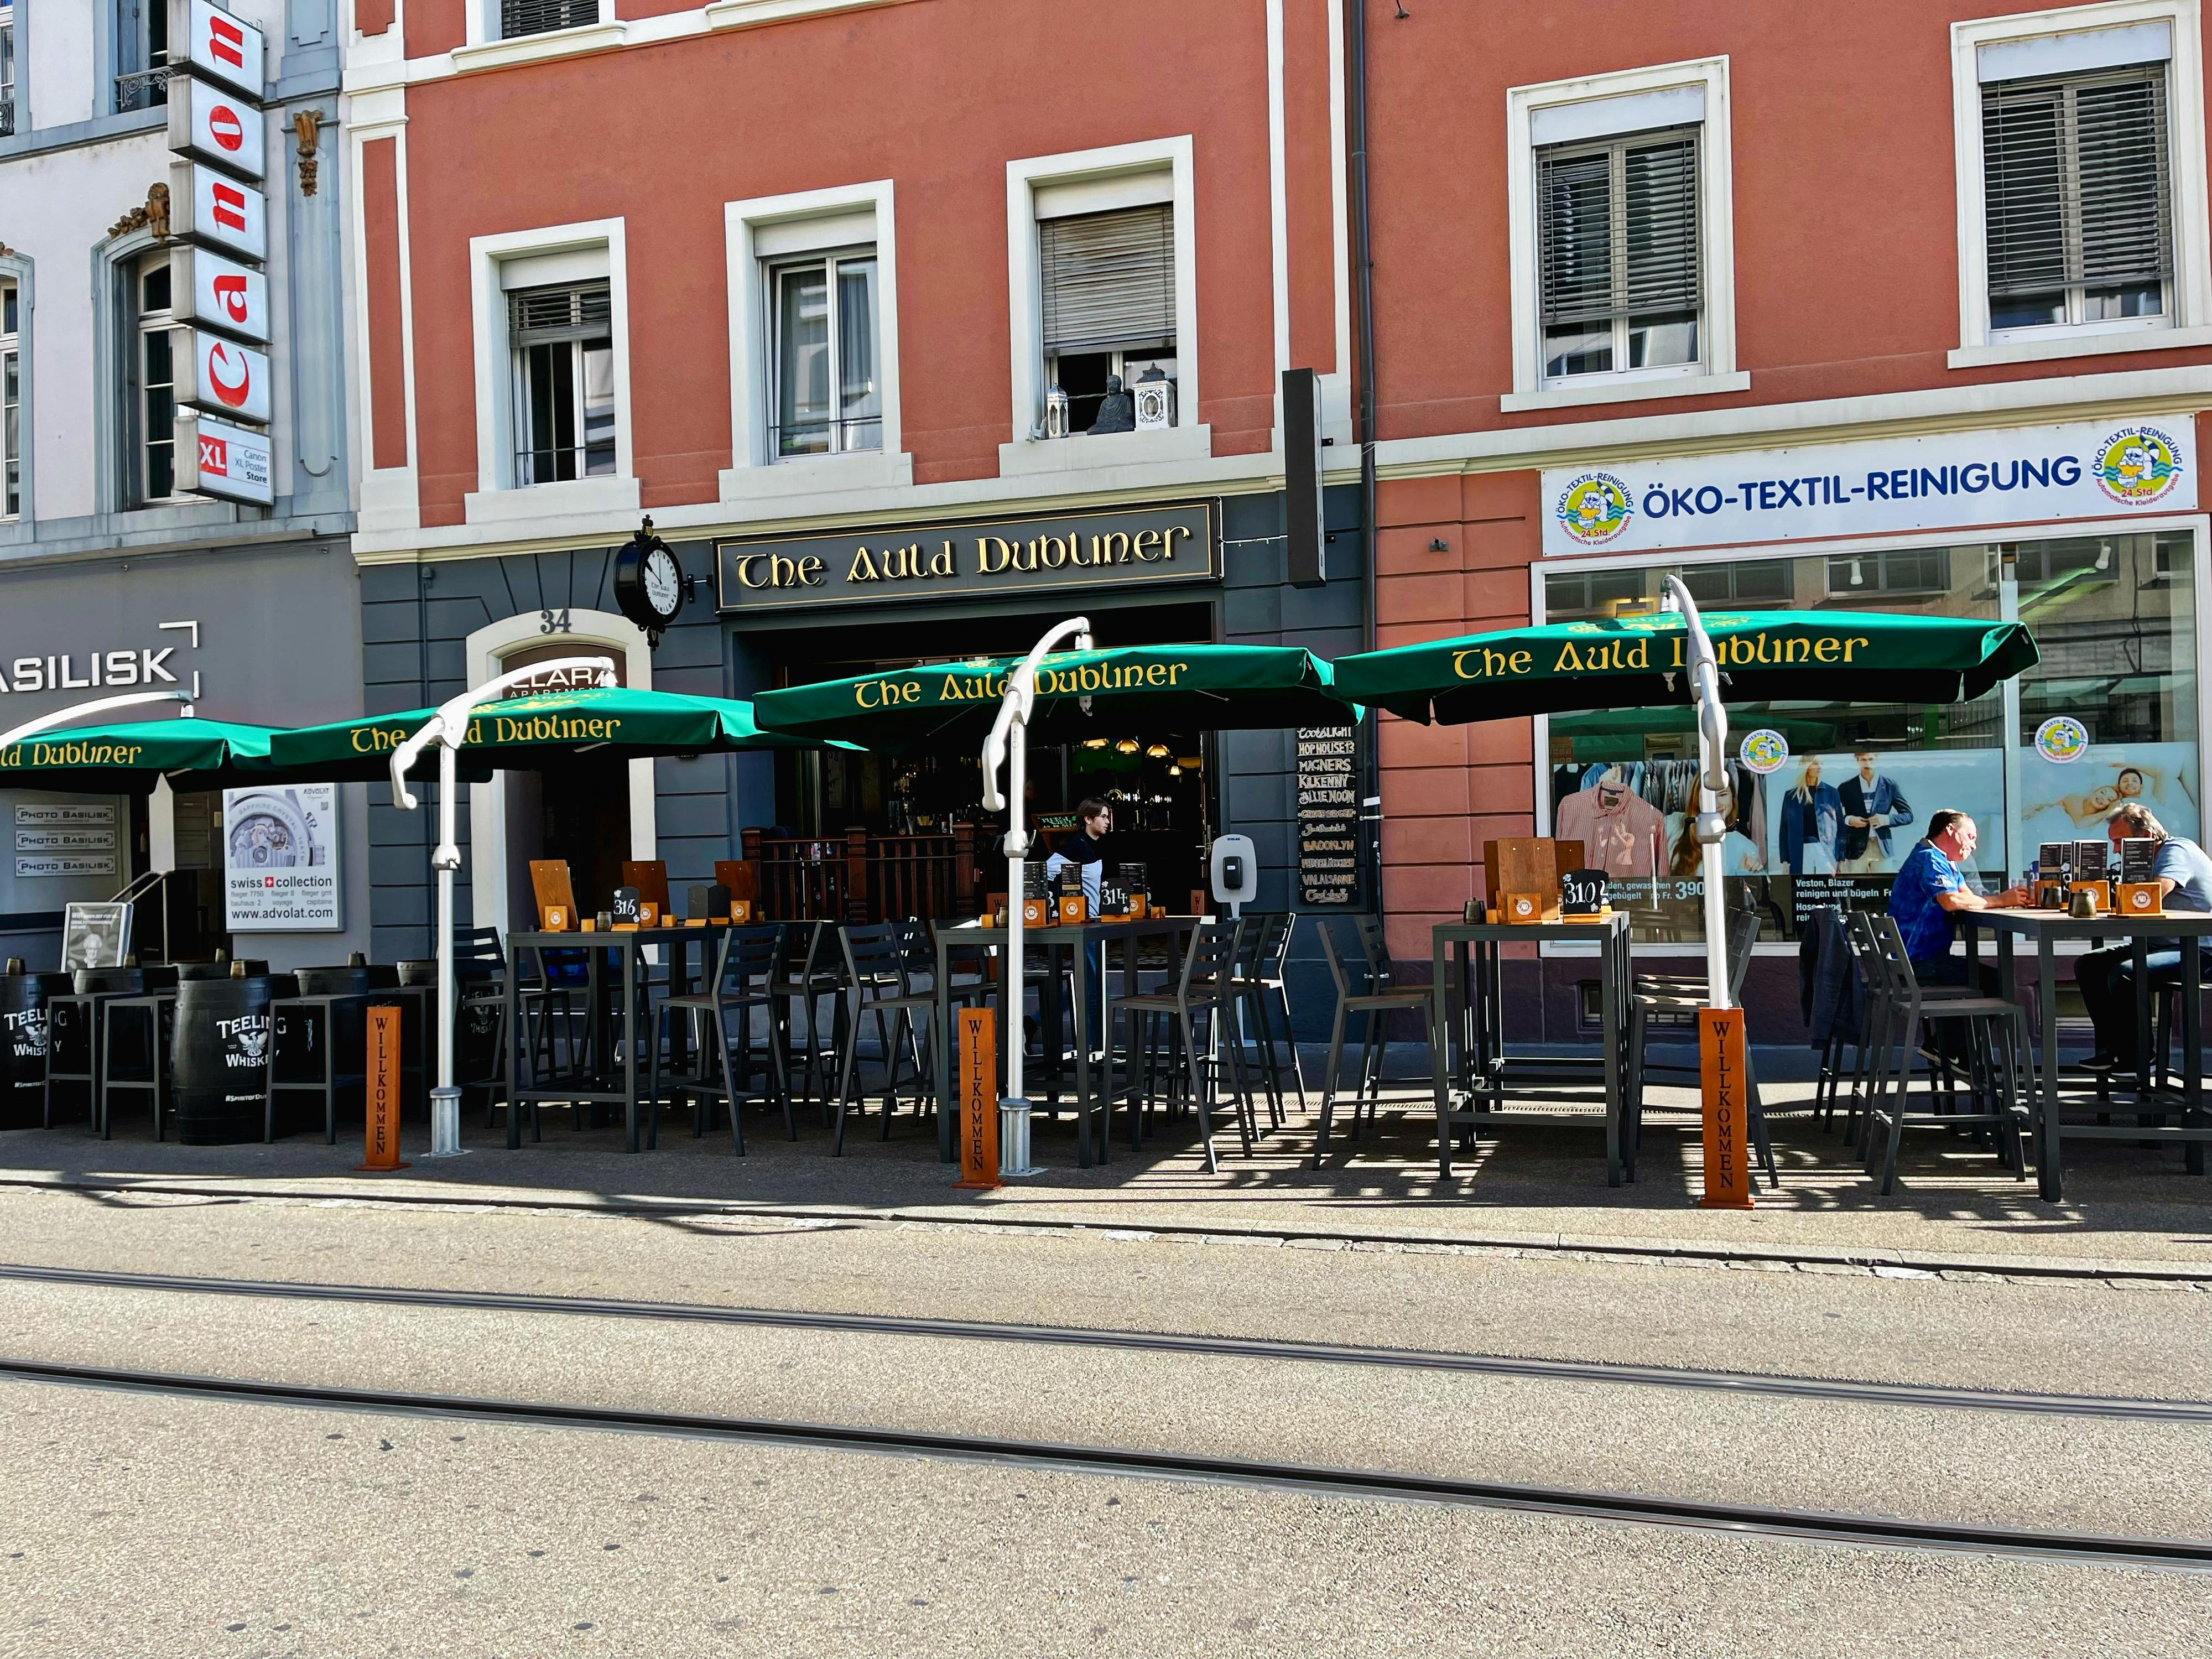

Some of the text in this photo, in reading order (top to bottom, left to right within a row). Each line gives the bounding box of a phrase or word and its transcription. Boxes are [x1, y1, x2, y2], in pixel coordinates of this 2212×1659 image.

[209, 16, 249, 408] Canon
[200, 442, 226, 469] XL
[244, 450, 267, 462] Canon
[2091, 427, 2182, 471] ÖKO-TEXTIL-REINIGUNG
[235, 458, 267, 472] XL Poster
[246, 471, 267, 483] Store
[1642, 455, 2082, 519] ÖKO-TEXTIL-REINIGUNG
[1555, 472, 1633, 513] ÖKO-TEXTIL-REINIGUNG
[2096, 473, 2179, 506] Automatische Kleiderausgabe
[2121, 487, 2156, 497] 24 Std.
[1559, 515, 1631, 545] Automatische Kleiderausgabe
[1594, 528, 1610, 537] Std.
[737, 525, 1190, 589] The Auld Dubliner
[540, 609, 571, 633] 34
[1452, 648, 1533, 679] The
[1554, 638, 1650, 672] Auld
[510, 667, 601, 688] LAR
[854, 680, 921, 708] The
[1034, 661, 1188, 695] Dubliner
[350, 728, 407, 752] The
[496, 715, 621, 743] Dubliner
[0, 741, 142, 767] ld Dubliner
[1299, 758, 1351, 772] MAGNERS
[1298, 774, 1349, 788] KILKENNY
[239, 803, 271, 814] SAPPHIRE
[273, 806, 298, 830] CRYSTAL
[1303, 840, 1354, 851] BROOKLYN
[231, 876, 332, 888] swiss collection
[1626, 882, 1670, 891] gewashen
[1796, 879, 1826, 888] Veston,
[1102, 888, 1127, 905] 314
[1564, 882, 1596, 904] 310
[1797, 890, 1830, 899] reinigen
[1850, 889, 1878, 898] bügeln
[231, 907, 332, 918] www.advolat.com
[613, 899, 636, 916] 316
[13, 1041, 61, 1056] WHISY
[226, 1050, 280, 1068] WHISK
[376, 1018, 388, 1154] WILLKOMMEN
[969, 1020, 983, 1170] WILLKOMMEN
[1712, 1022, 1734, 1188] WILLKOMMEN
